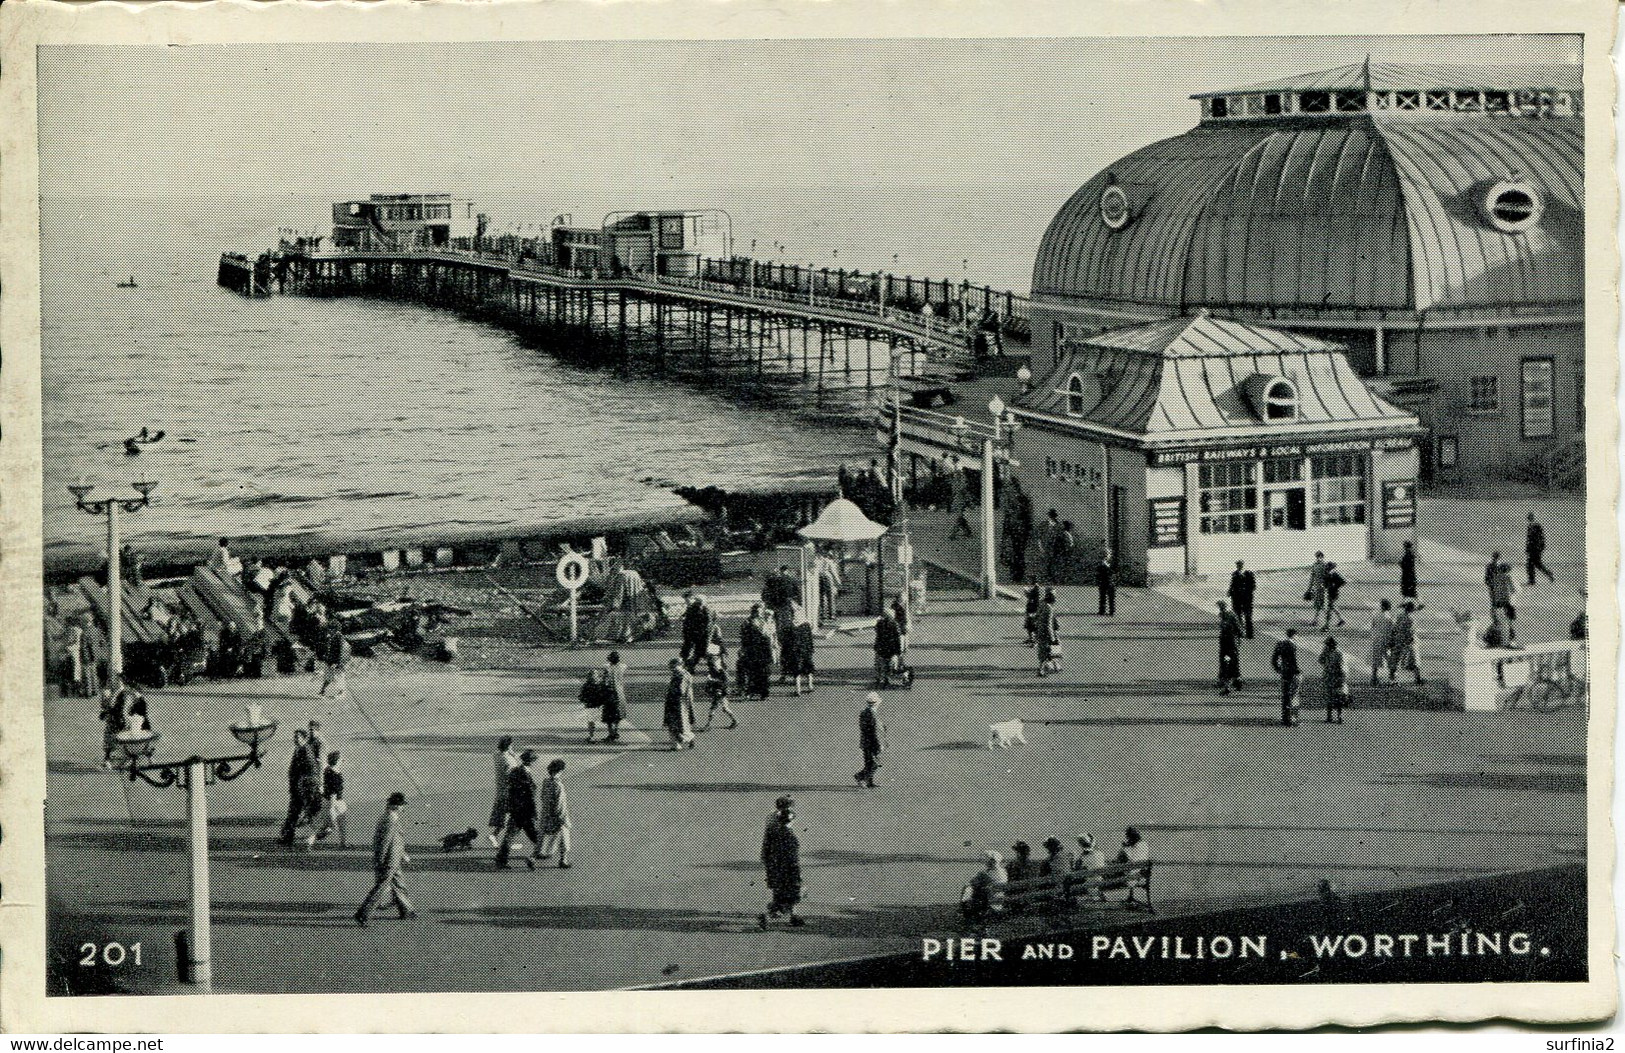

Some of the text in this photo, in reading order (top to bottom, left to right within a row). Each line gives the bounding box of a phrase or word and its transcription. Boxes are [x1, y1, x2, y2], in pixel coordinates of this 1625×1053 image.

[1158, 452, 1199, 463] BRITISH
[1203, 447, 1256, 460] RAILWAYS
[1271, 446, 1300, 456] LOCAL
